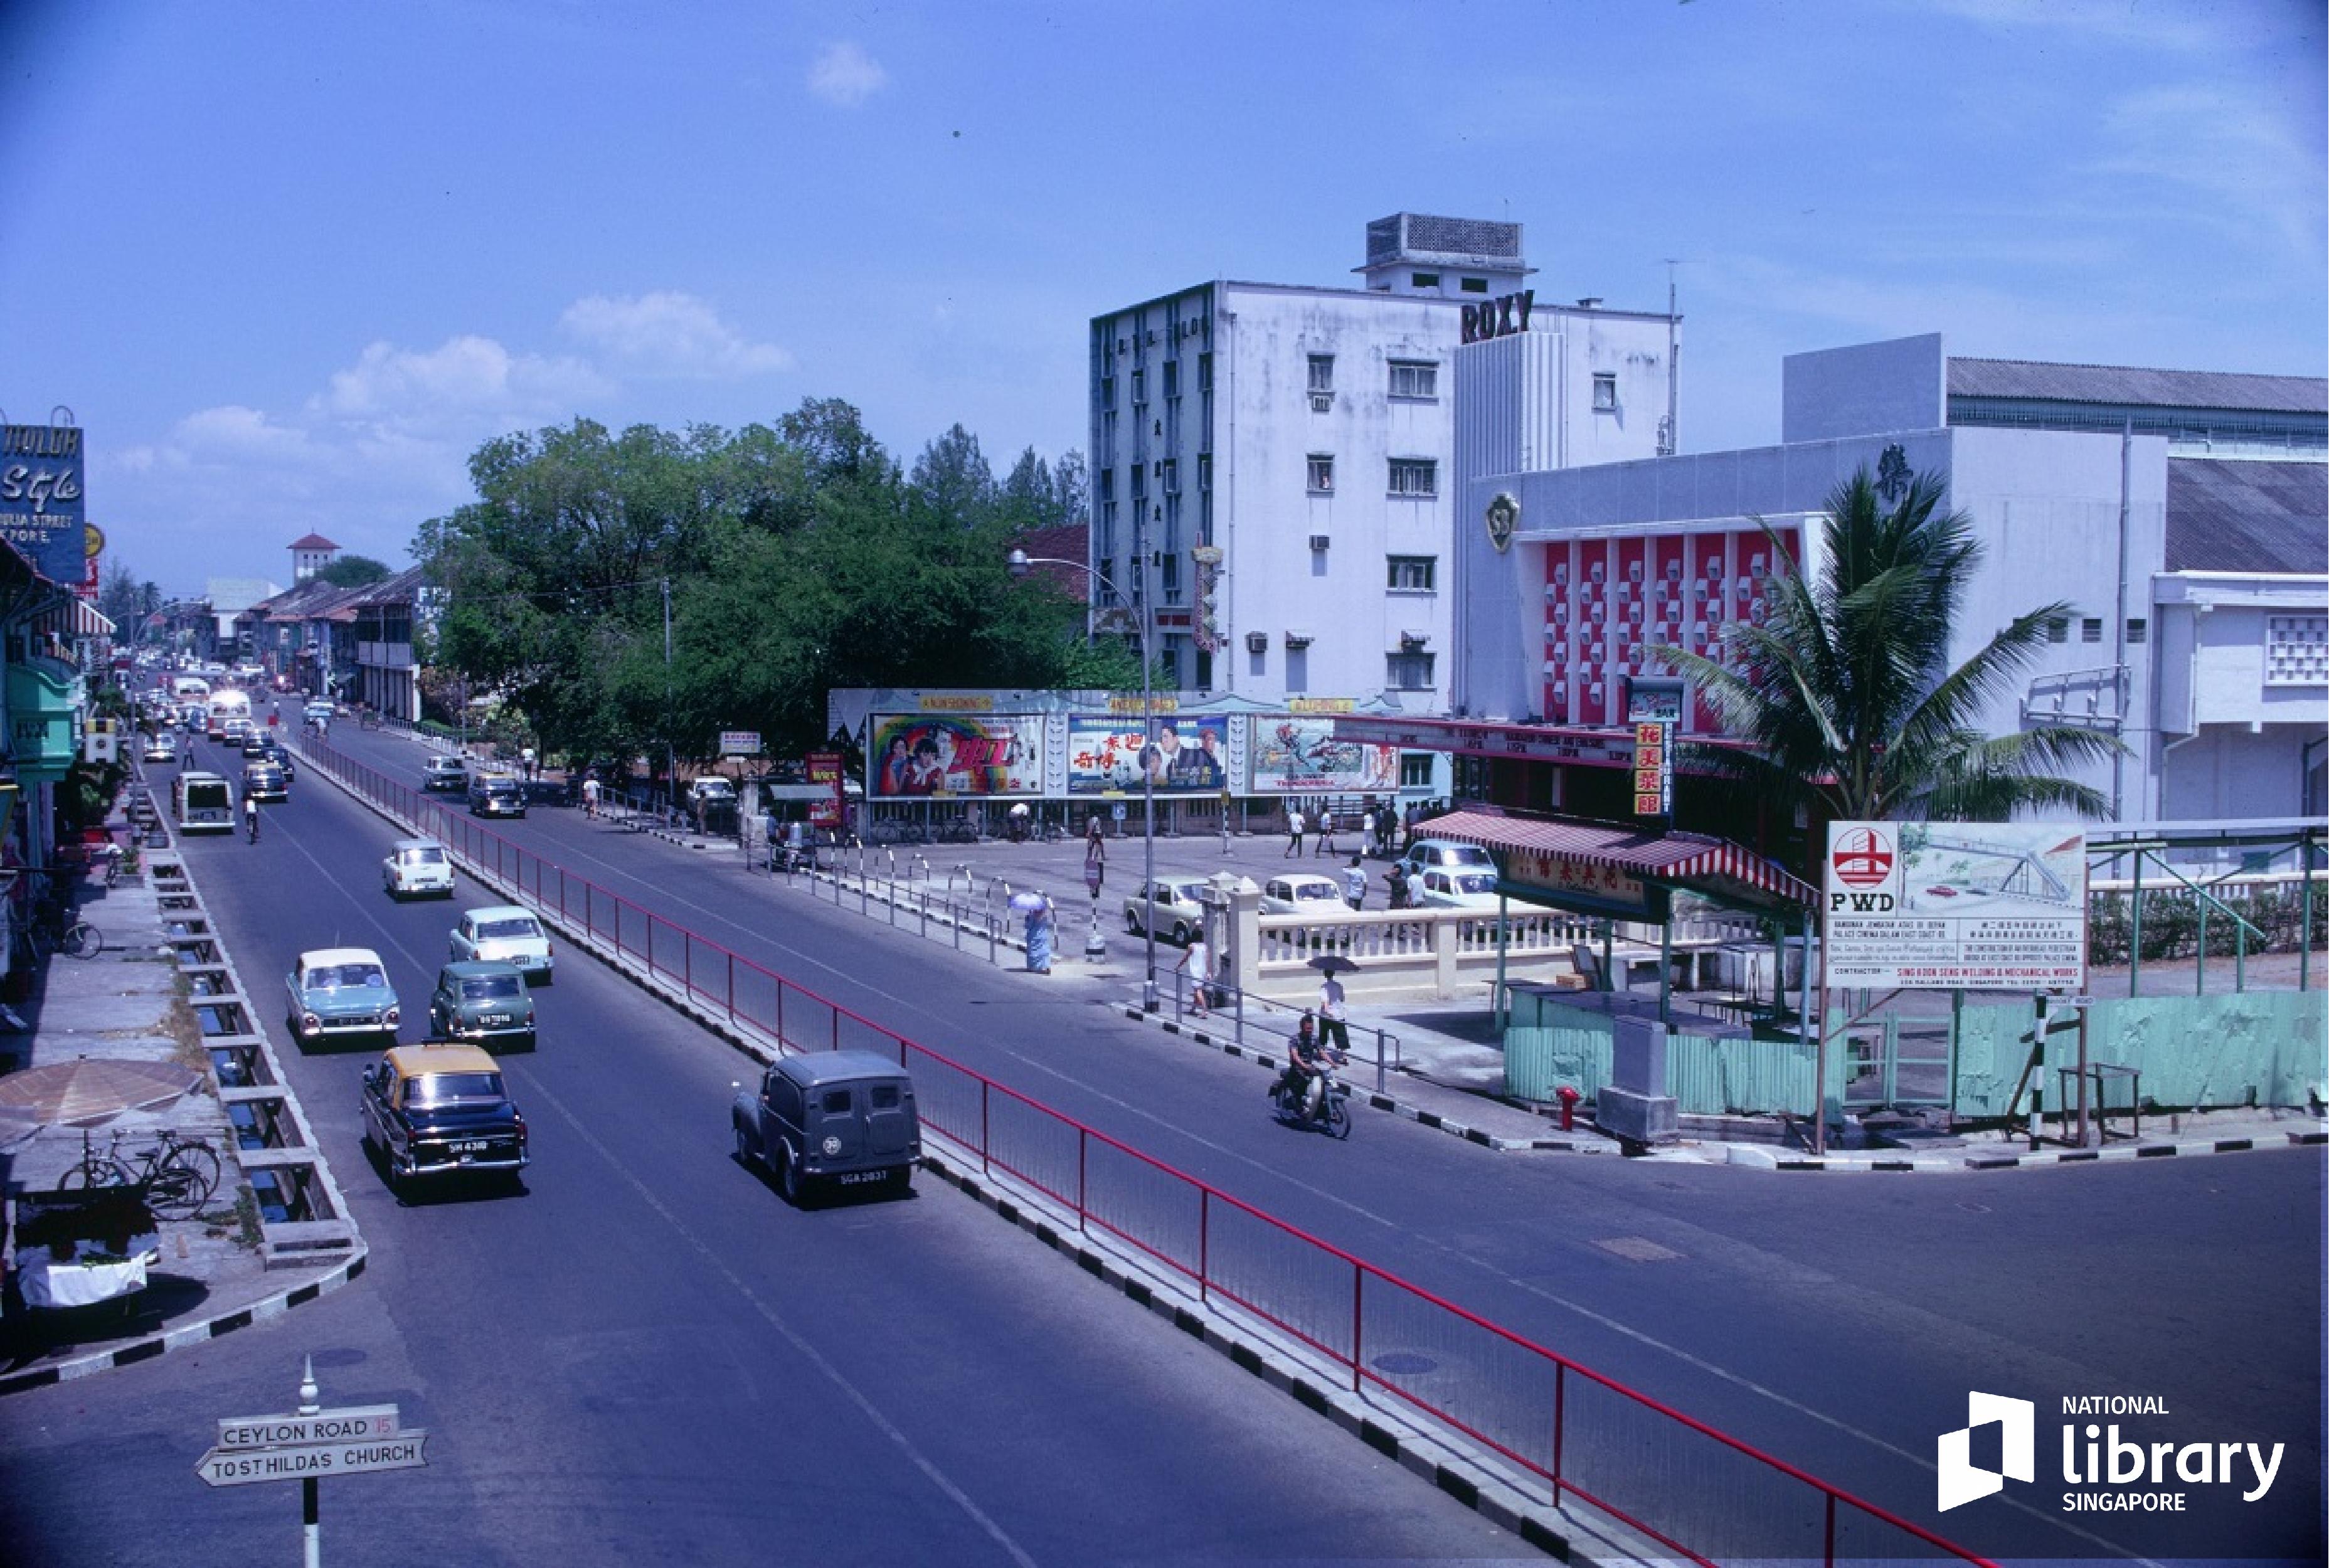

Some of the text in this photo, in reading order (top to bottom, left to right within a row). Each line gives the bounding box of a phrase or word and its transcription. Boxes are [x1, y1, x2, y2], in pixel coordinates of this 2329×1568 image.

[1461, 289, 1534, 346] ROXY
[1830, 893, 1894, 912] PWD
[224, 1419, 391, 1444] CEYLON ROAD 15
[213, 1462, 236, 1478] TO
[346, 1444, 416, 1465] CHURCH
